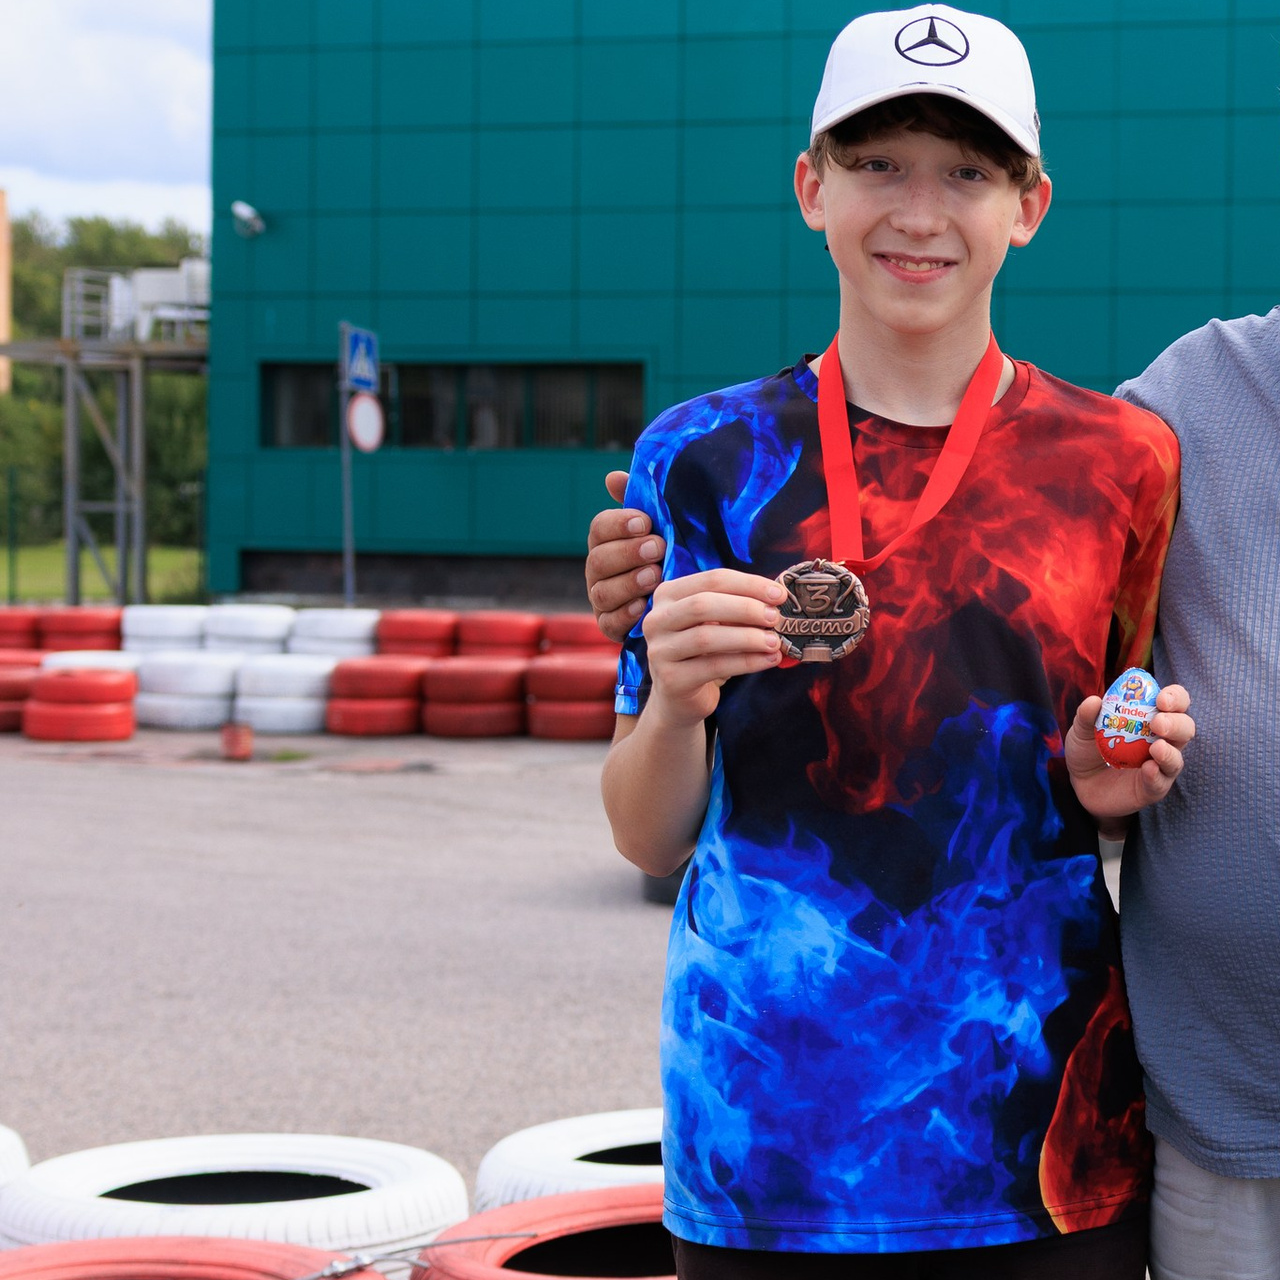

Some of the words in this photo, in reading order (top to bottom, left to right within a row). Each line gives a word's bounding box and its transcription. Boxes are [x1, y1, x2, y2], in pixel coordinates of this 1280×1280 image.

[805, 585, 831, 613] 3
[1114, 704, 1149, 719] Kinder
[1102, 714, 1156, 737] СЮРПРИ
